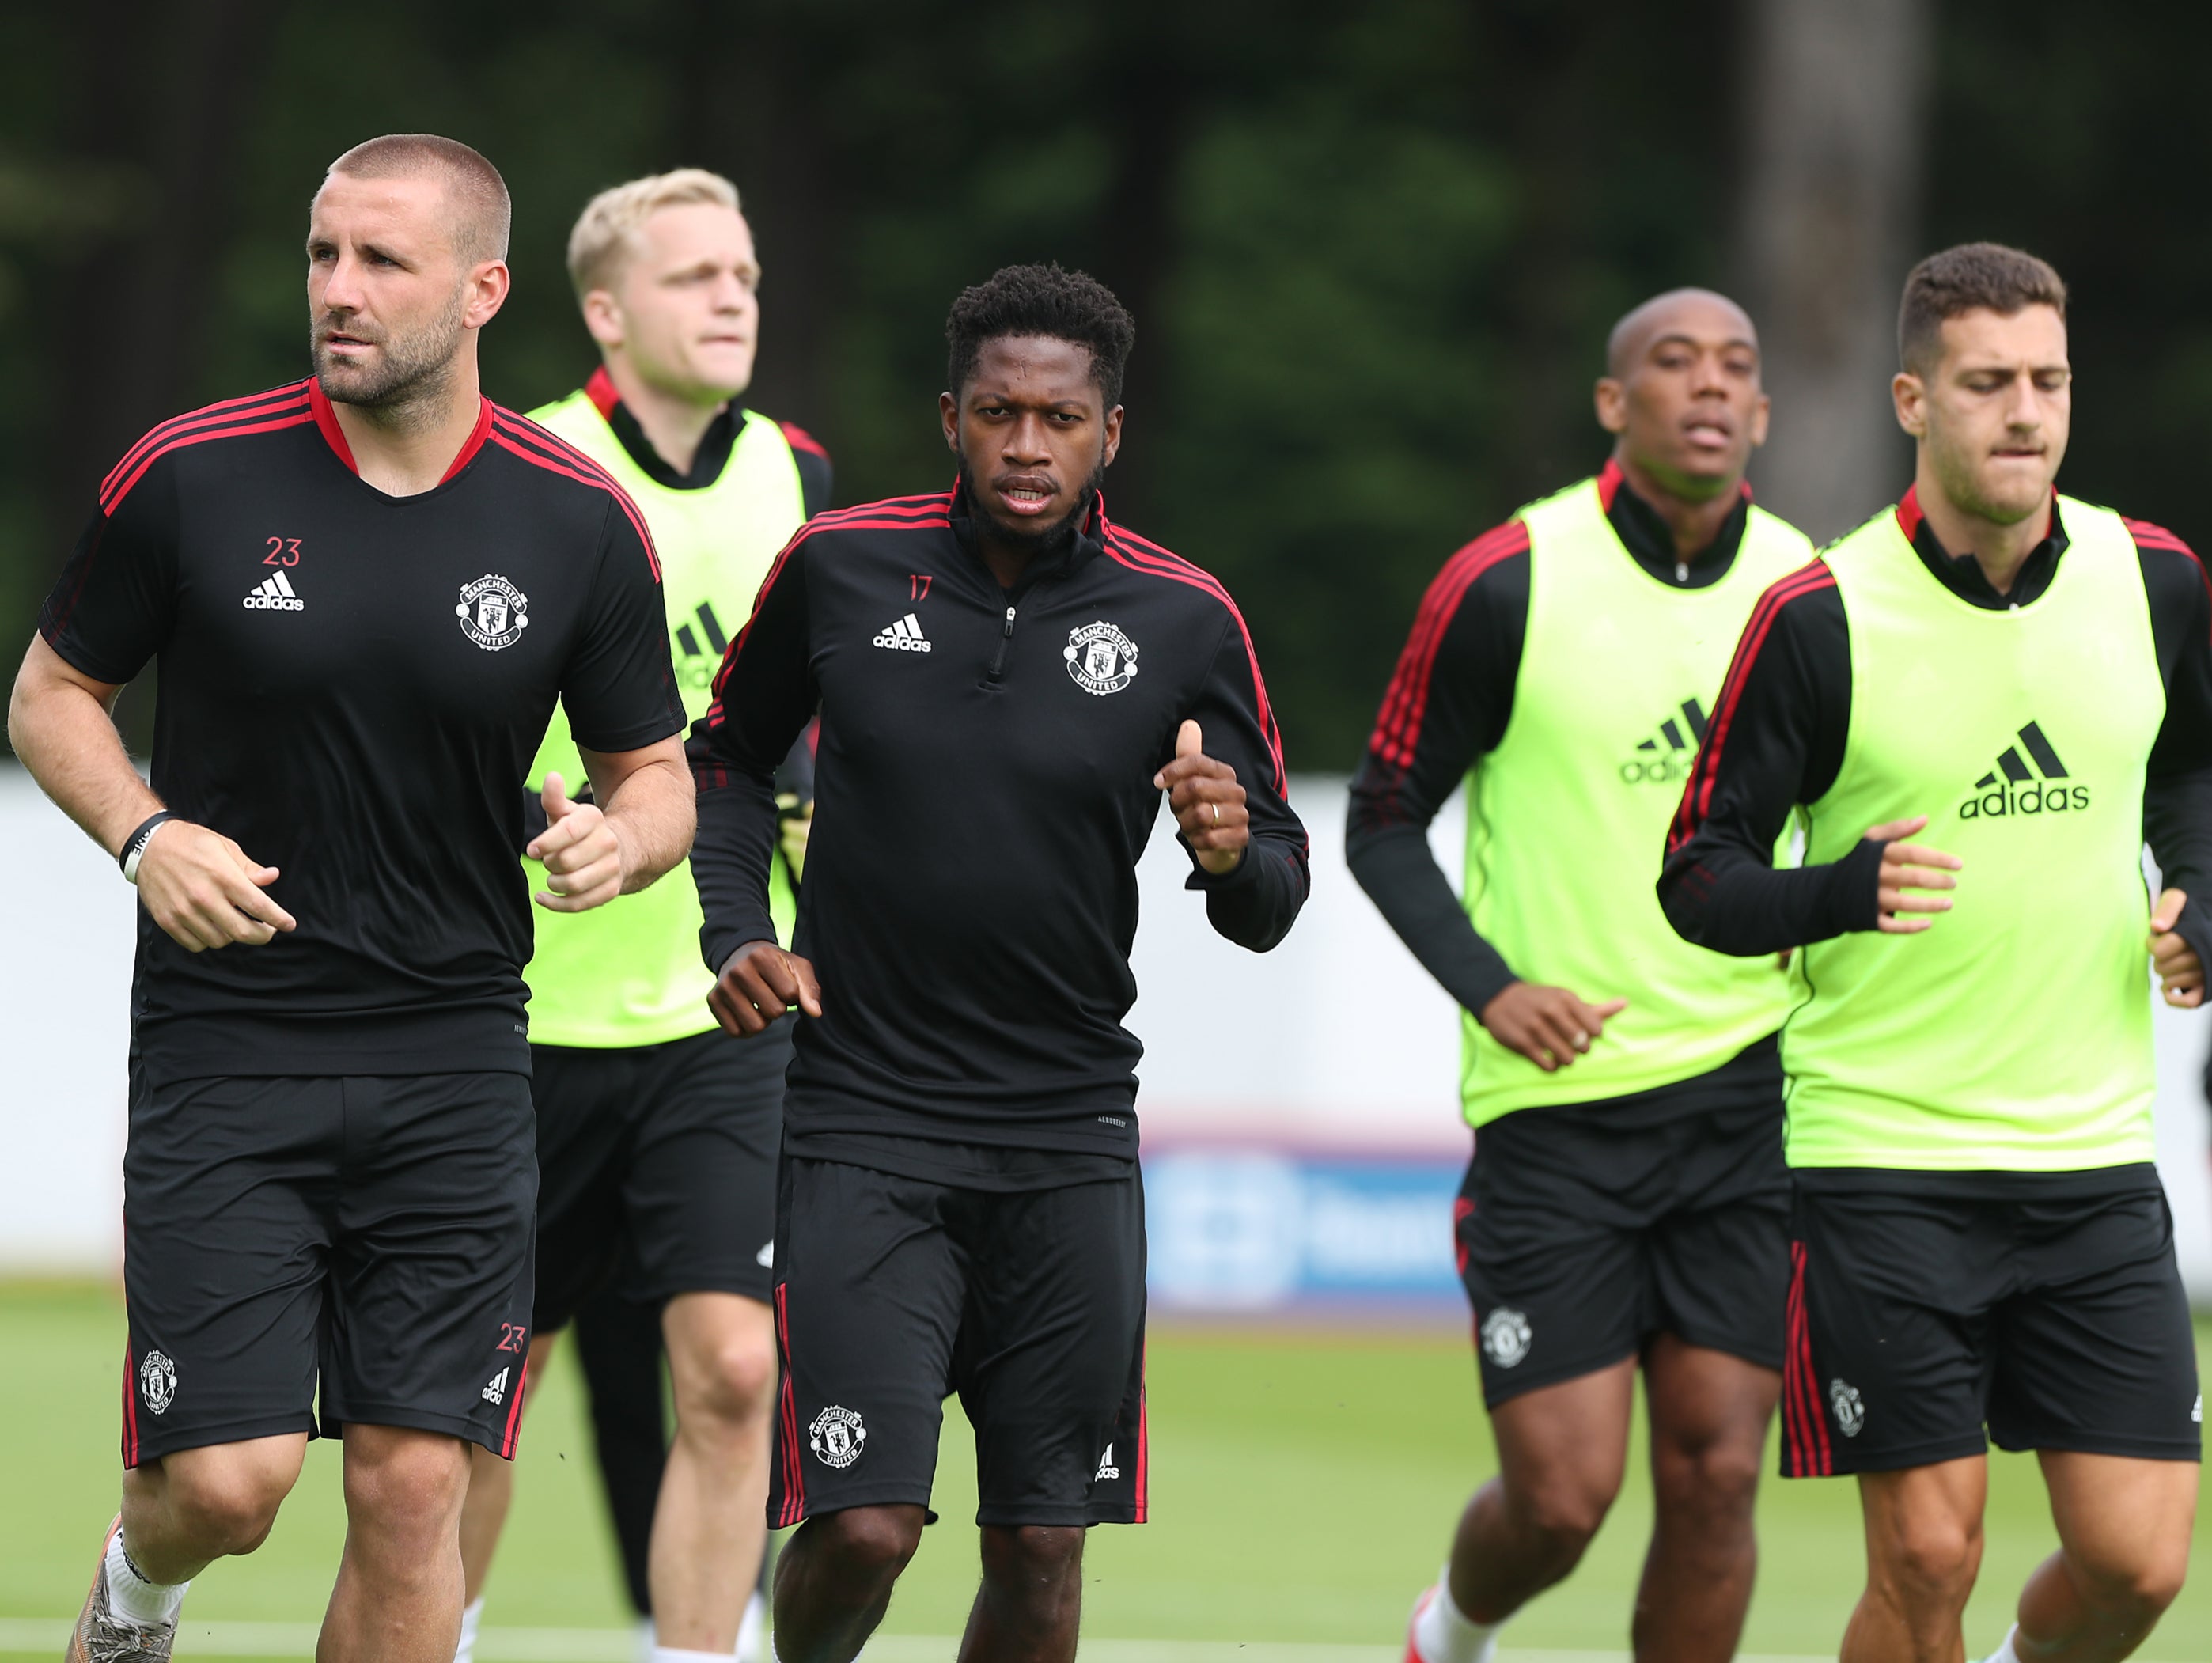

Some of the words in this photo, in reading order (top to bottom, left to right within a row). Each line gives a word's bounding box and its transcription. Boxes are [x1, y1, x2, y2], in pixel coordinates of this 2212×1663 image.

[262, 536, 303, 567] 23
[464, 580, 522, 609] MANCHESTER
[910, 574, 933, 601] 17
[242, 593, 305, 612] adidas
[470, 629, 511, 646] UNITED
[873, 632, 931, 653] adidas
[1074, 627, 1133, 657] MANCHESTER
[1076, 672, 1119, 690] UNITED
[1959, 782, 2089, 820] adidas
[496, 1322, 526, 1354] 23
[143, 1354, 171, 1377] MANCHESTER
[150, 1397, 169, 1410] UNITED
[814, 1410, 858, 1435] MANCHESTER
[827, 1449, 857, 1464] UNITED
